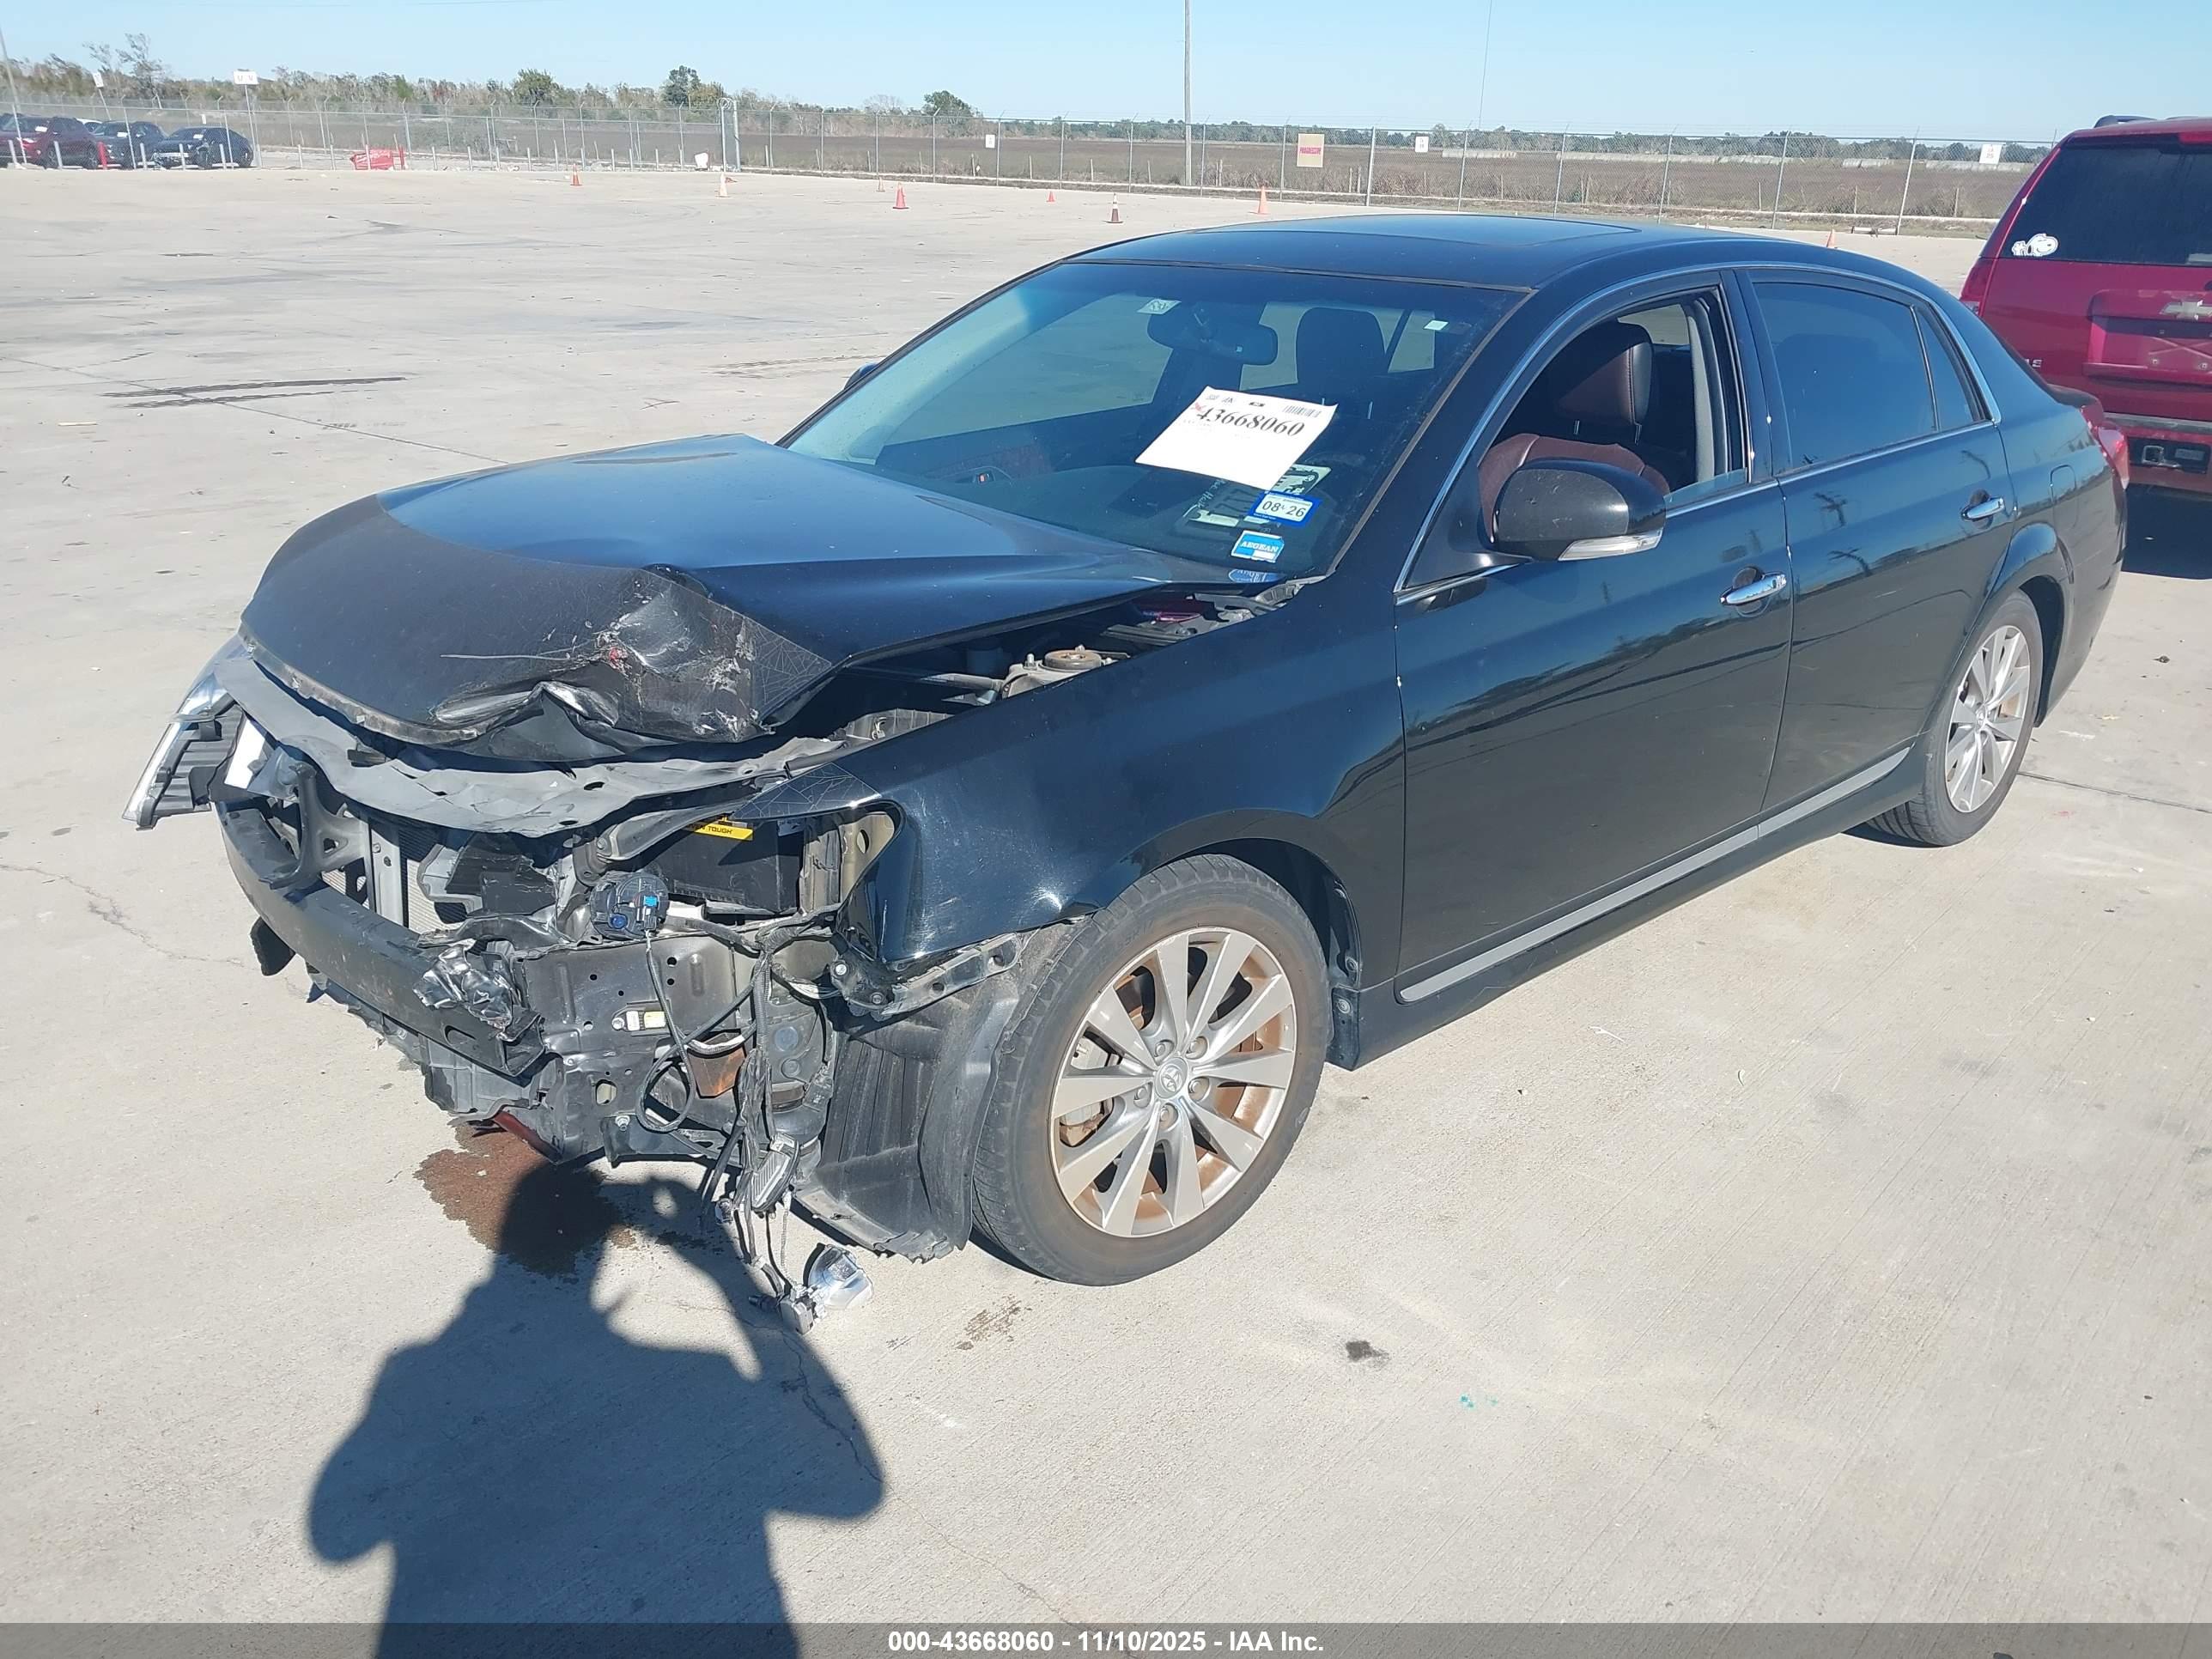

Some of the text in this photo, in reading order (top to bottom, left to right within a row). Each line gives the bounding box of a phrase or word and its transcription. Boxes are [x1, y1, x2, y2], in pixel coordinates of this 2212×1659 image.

[1196, 407, 1305, 436] 43668060
[1261, 501, 1281, 513] 08
[1285, 505, 1306, 517] 26
[1241, 540, 1279, 552] AEGEAN
[708, 825, 733, 834] TOUGH
